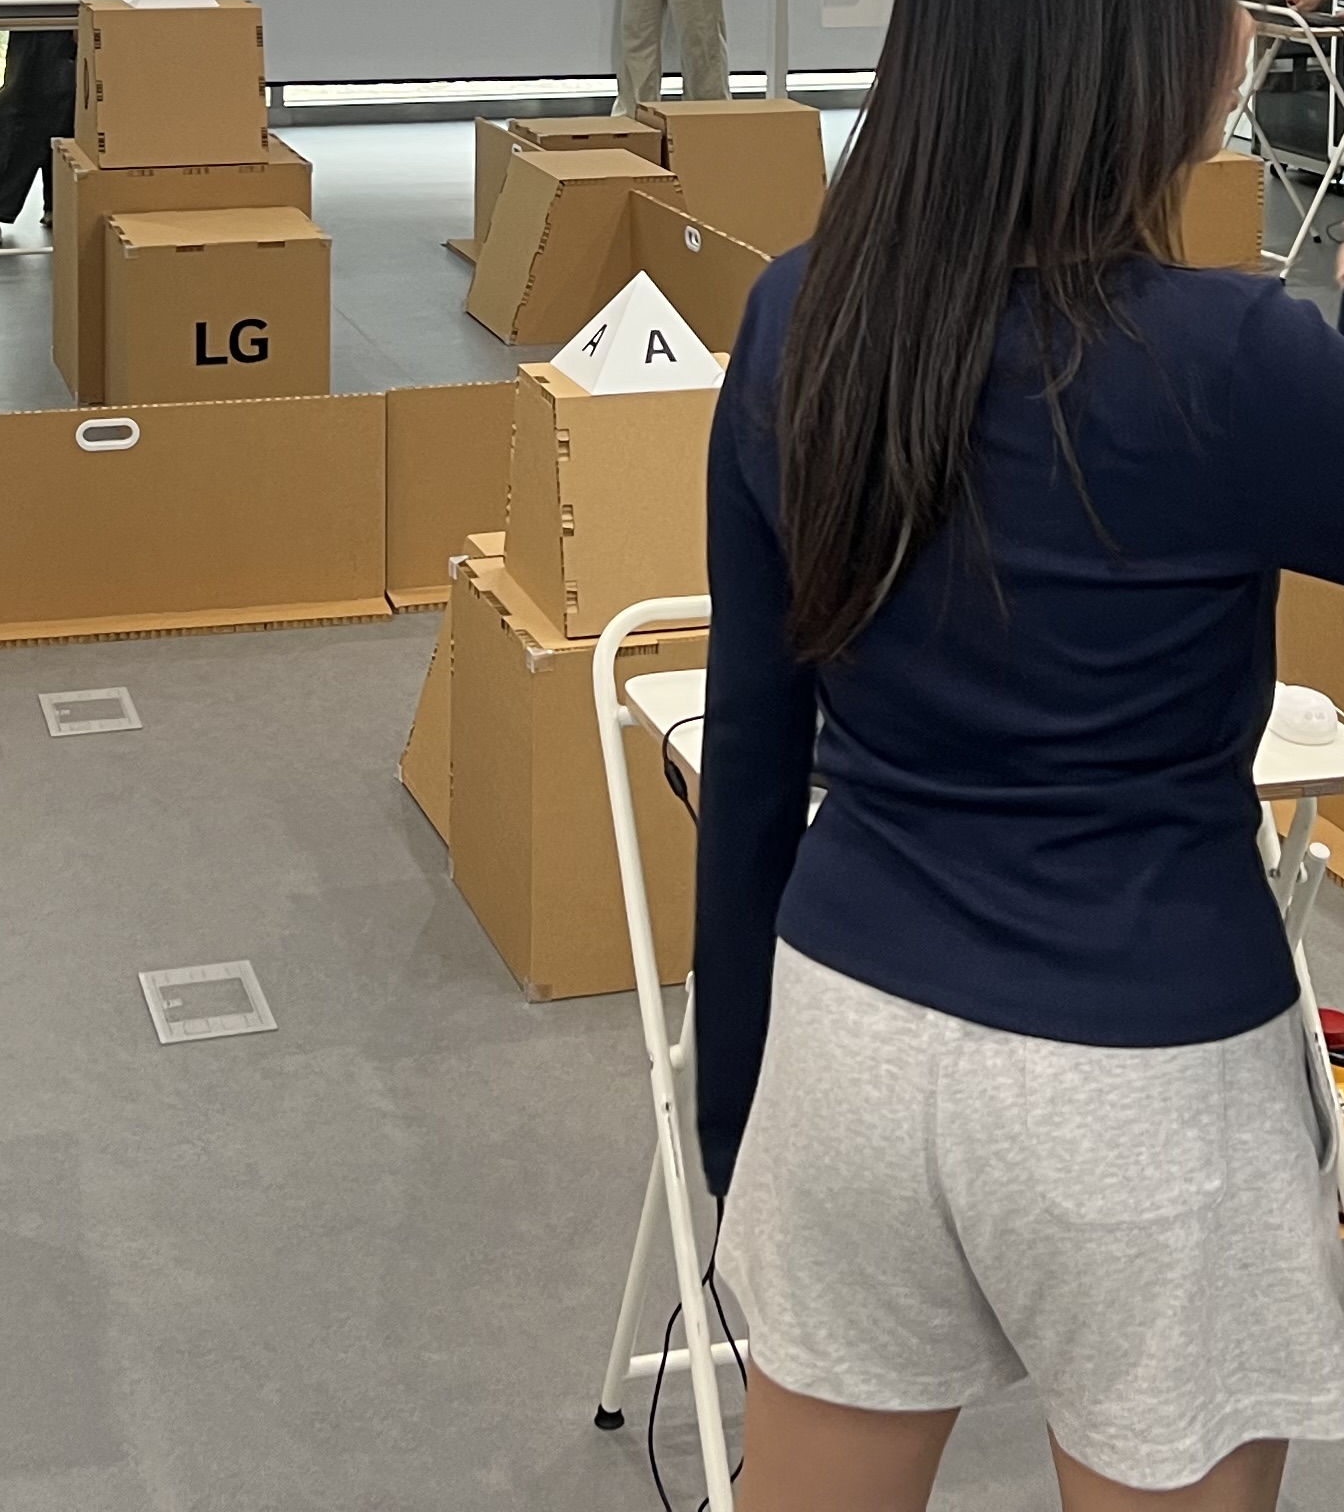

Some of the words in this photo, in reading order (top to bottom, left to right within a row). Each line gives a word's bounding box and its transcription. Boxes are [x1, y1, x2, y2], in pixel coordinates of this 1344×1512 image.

[196, 318, 269, 366] LG
[581, 323, 608, 358] A
[645, 329, 678, 364] A
